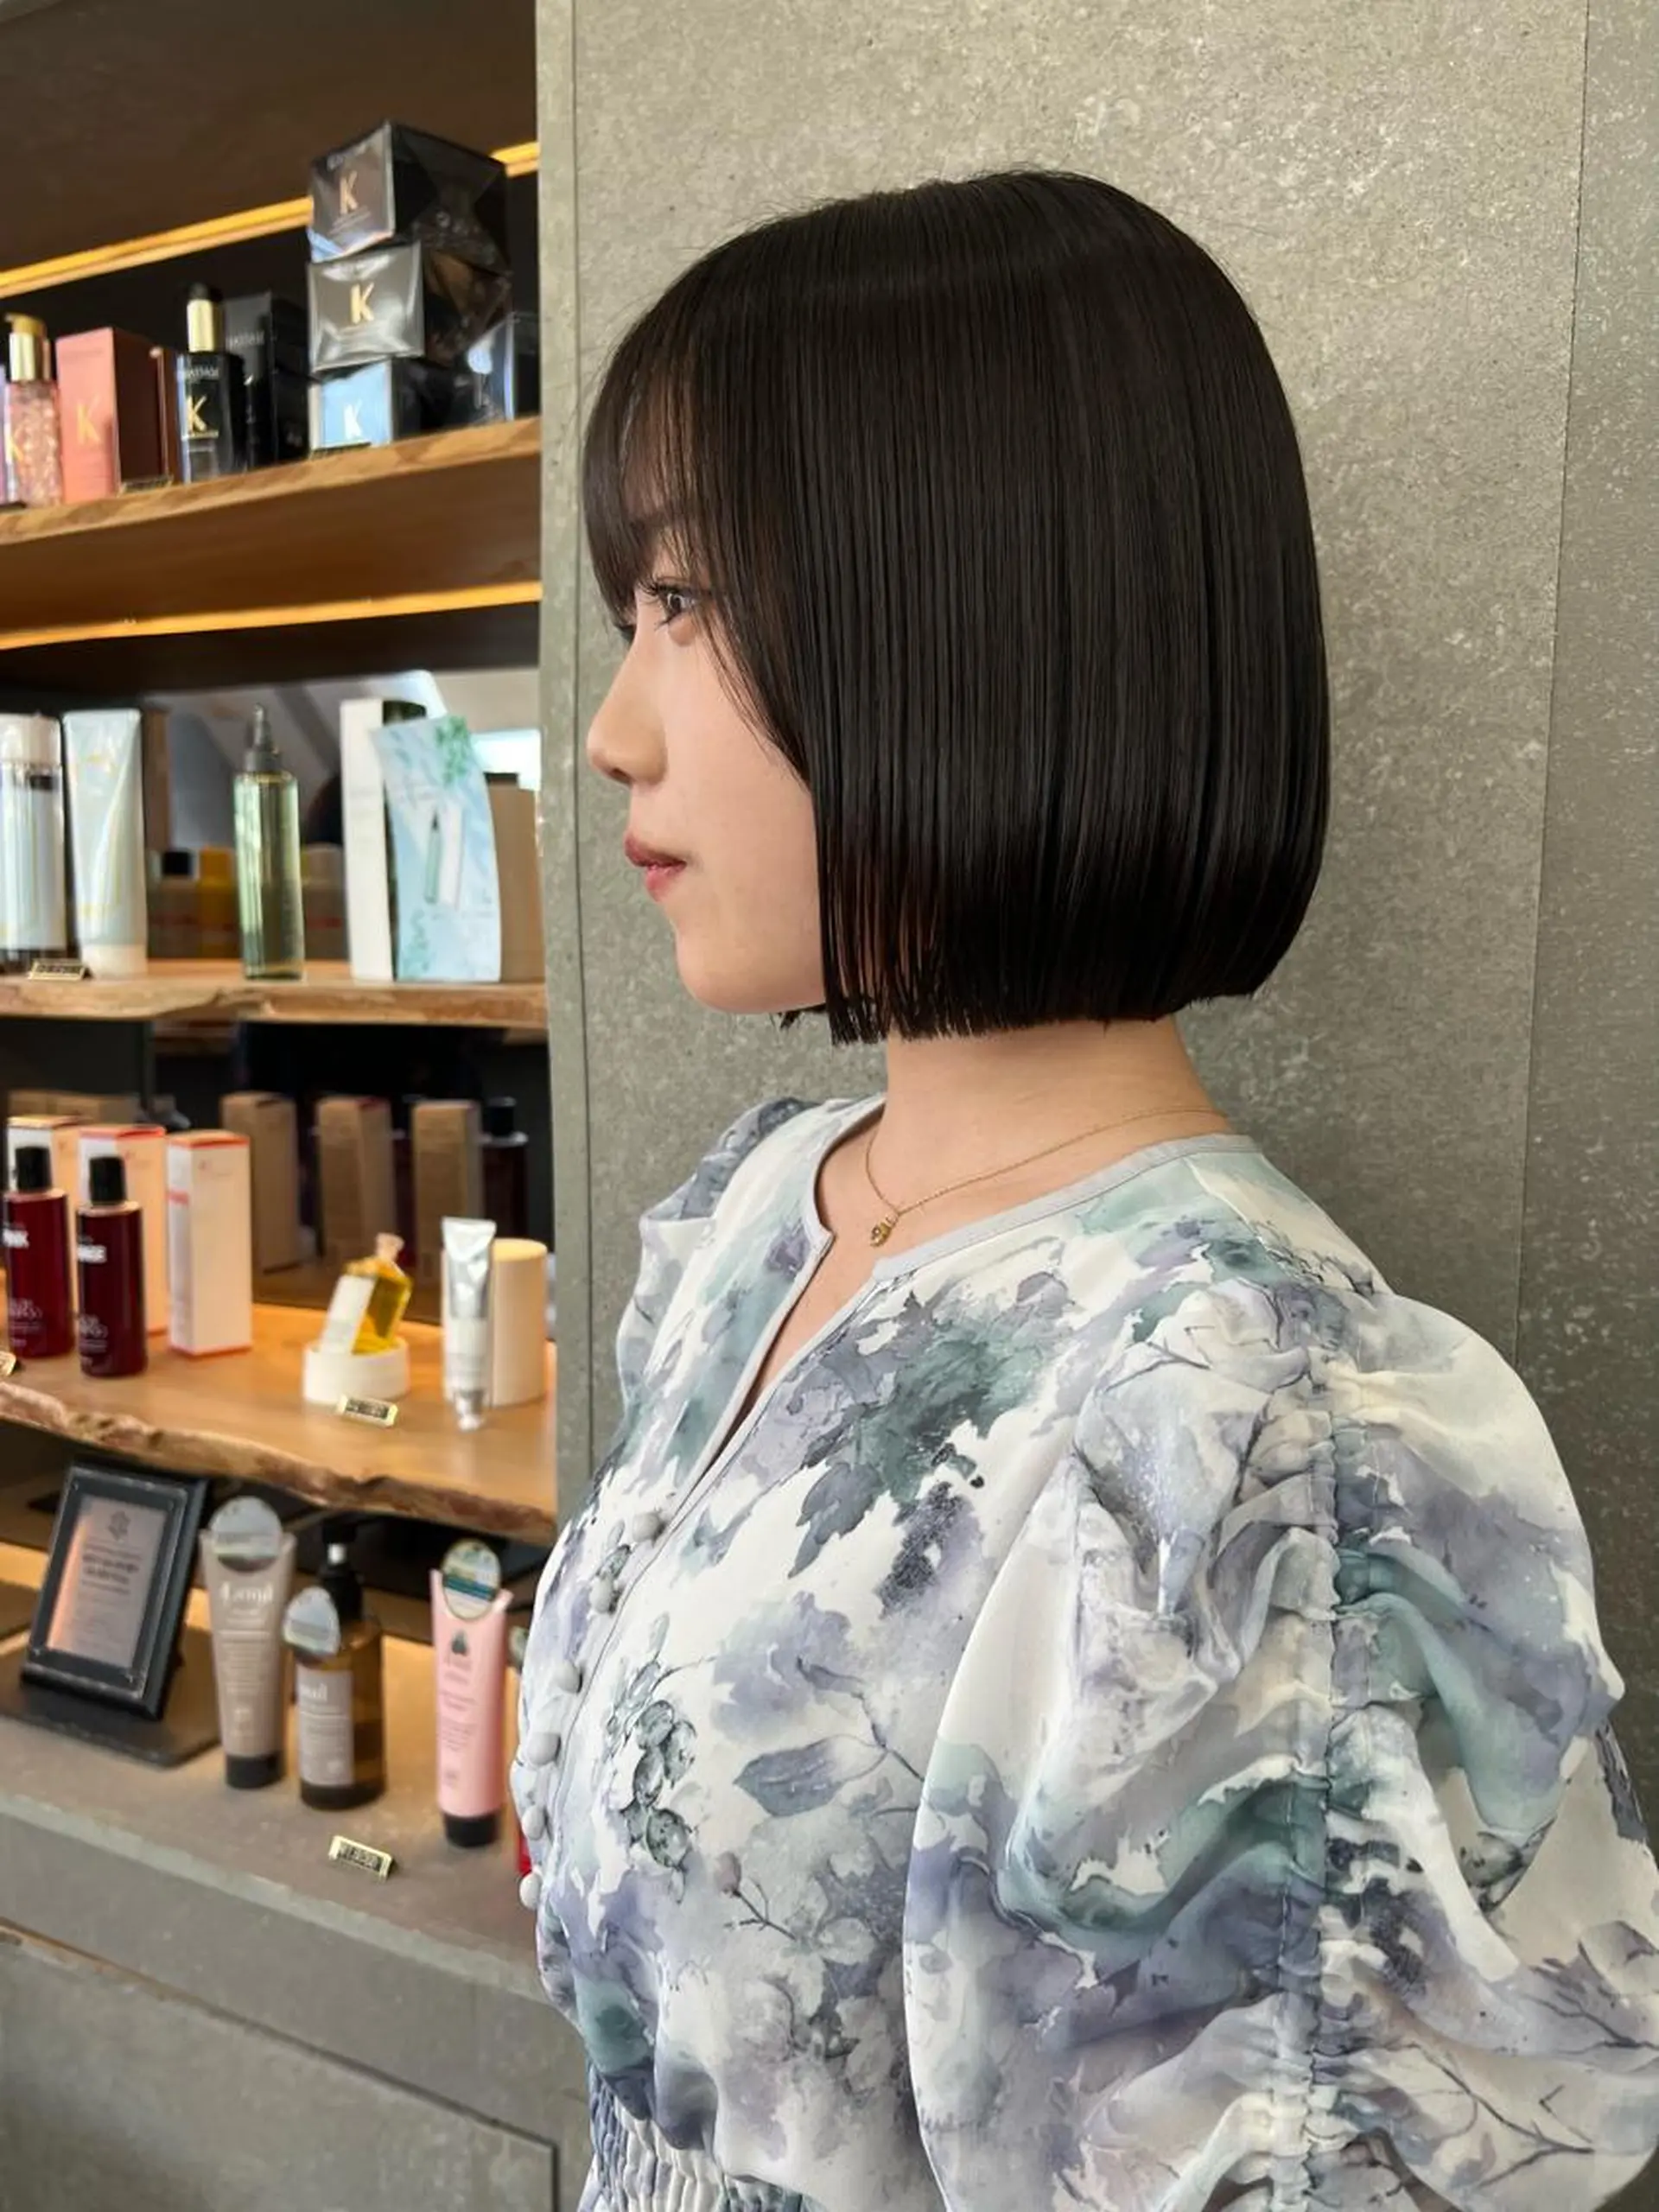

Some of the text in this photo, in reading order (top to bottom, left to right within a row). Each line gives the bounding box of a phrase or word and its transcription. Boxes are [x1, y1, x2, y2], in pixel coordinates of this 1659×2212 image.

[340, 170, 358, 214] K
[350, 282, 374, 325] K
[76, 394, 103, 446] K
[187, 394, 207, 435] K
[344, 400, 362, 437] K
